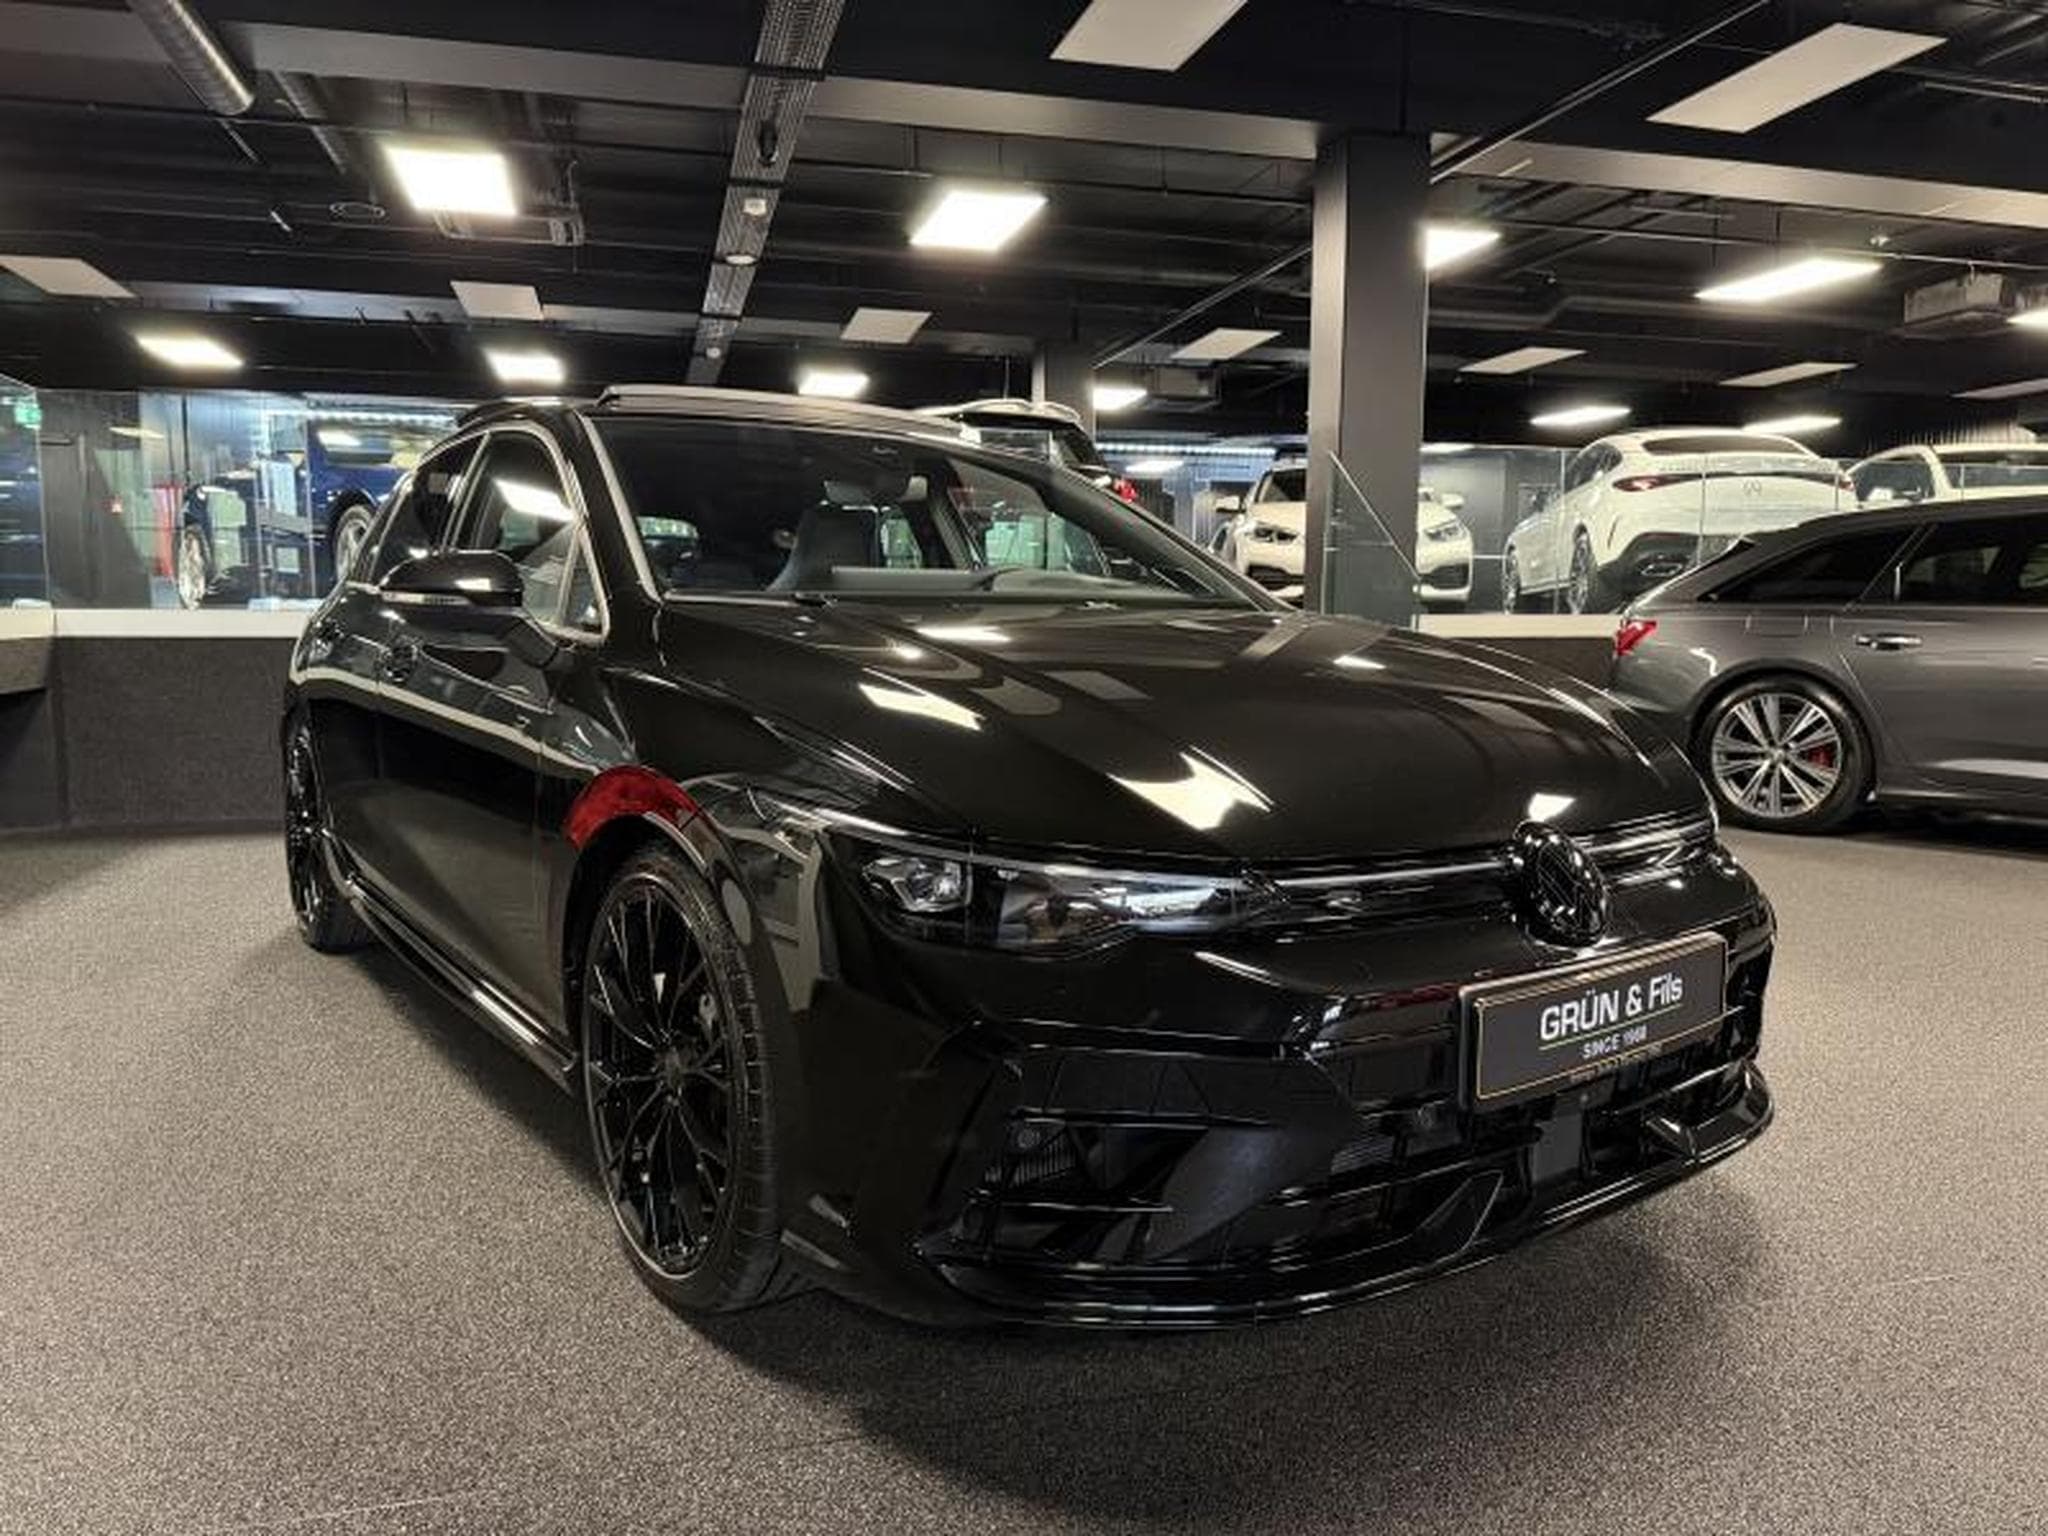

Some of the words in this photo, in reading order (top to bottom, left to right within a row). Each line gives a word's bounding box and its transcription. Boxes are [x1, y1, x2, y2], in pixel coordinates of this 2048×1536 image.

[1540, 988, 1619, 1040] GRÜN
[1625, 984, 1643, 1017] &
[1649, 972, 1683, 1010] Fils
[1582, 1035, 1620, 1059] SINCE
